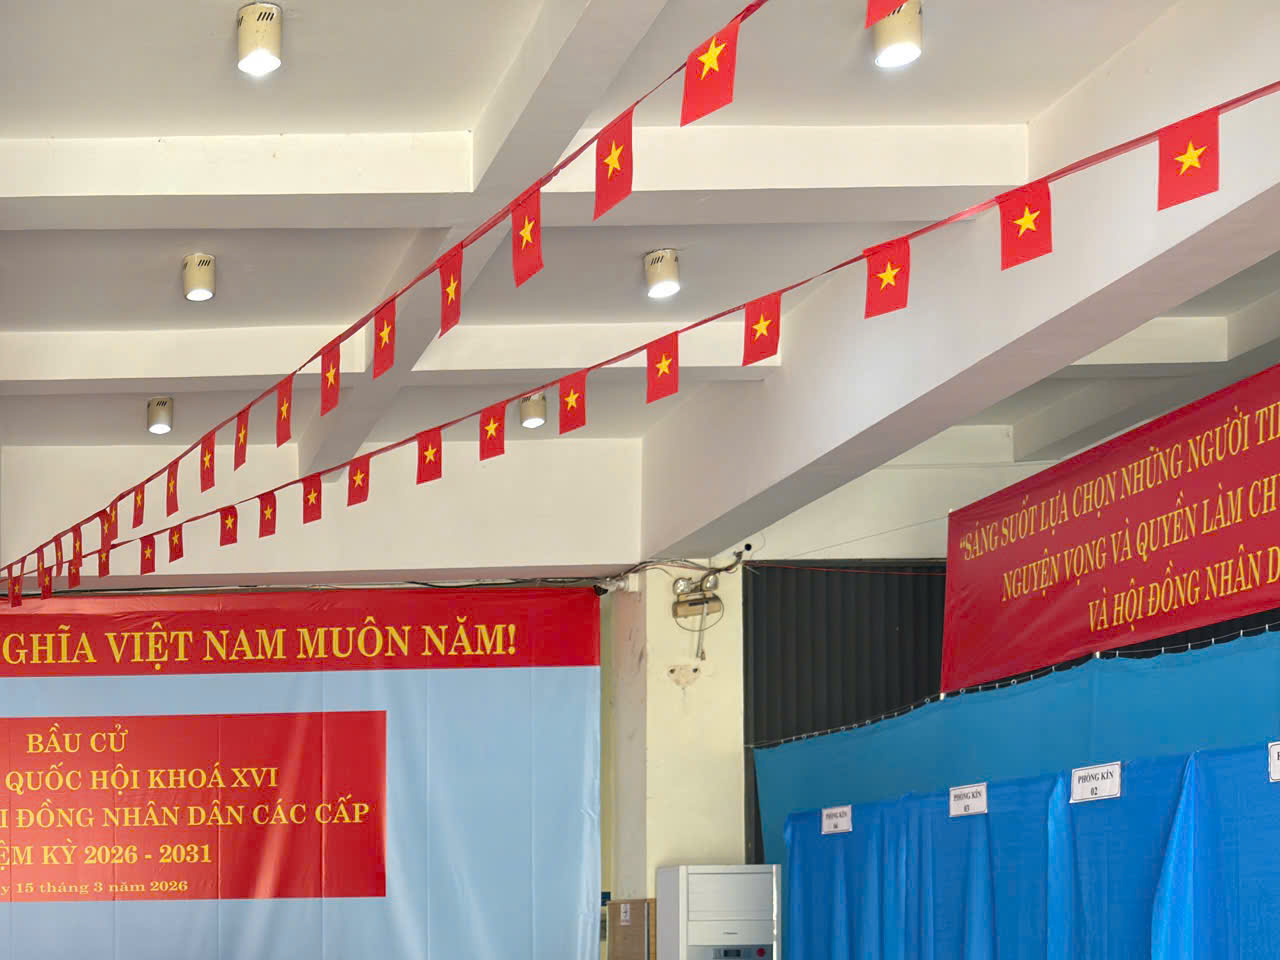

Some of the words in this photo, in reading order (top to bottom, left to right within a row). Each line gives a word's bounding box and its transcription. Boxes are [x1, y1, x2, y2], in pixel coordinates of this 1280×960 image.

[1001, 495, 1038, 547] SUỐT
[1040, 489, 1069, 536] LỰA
[1072, 470, 1117, 518] CHỌN
[1120, 446, 1183, 500] NHỮNG
[1187, 405, 1251, 473] NGƯỜI
[1255, 401, 1280, 446] TI
[1001, 547, 1061, 602] NGUYỆN
[1063, 536, 1107, 586] VỌNG
[1110, 517, 1133, 565] VÀ
[1136, 490, 1198, 562] QUYỀN
[1201, 482, 1244, 535] LÀM
[1248, 474, 1280, 518] CH
[1088, 586, 1109, 632] VÀ
[1111, 577, 1145, 632] HỘI
[1147, 559, 1201, 616] ĐỒNG
[1204, 544, 1263, 601] NHÂN
[105, 621, 193, 671] VIỆT
[202, 628, 288, 662] NAM
[296, 615, 412, 659] MUÔN
[421, 615, 517, 657] NĂM!
[26, 723, 82, 754] BẦU
[89, 724, 129, 753] CỬ
[4, 762, 83, 796] QUỐC
[91, 763, 139, 796] HỘI
[148, 761, 225, 789] KHOÁ
[231, 767, 279, 788] XVI
[15, 798, 95, 829] ĐỒNG
[101, 801, 180, 828] NHÂN
[187, 799, 245, 826] DÂN
[252, 798, 306, 825] CÁC
[315, 794, 369, 824] CẤP
[41, 838, 77, 865] KỲ
[84, 844, 138, 865] 2026
[159, 844, 212, 864] 2031
[16, 882, 34, 894] 15
[39, 882, 89, 896] tháng
[94, 882, 103, 893] 3
[108, 882, 146, 893] năm
[149, 880, 188, 892] 2026
